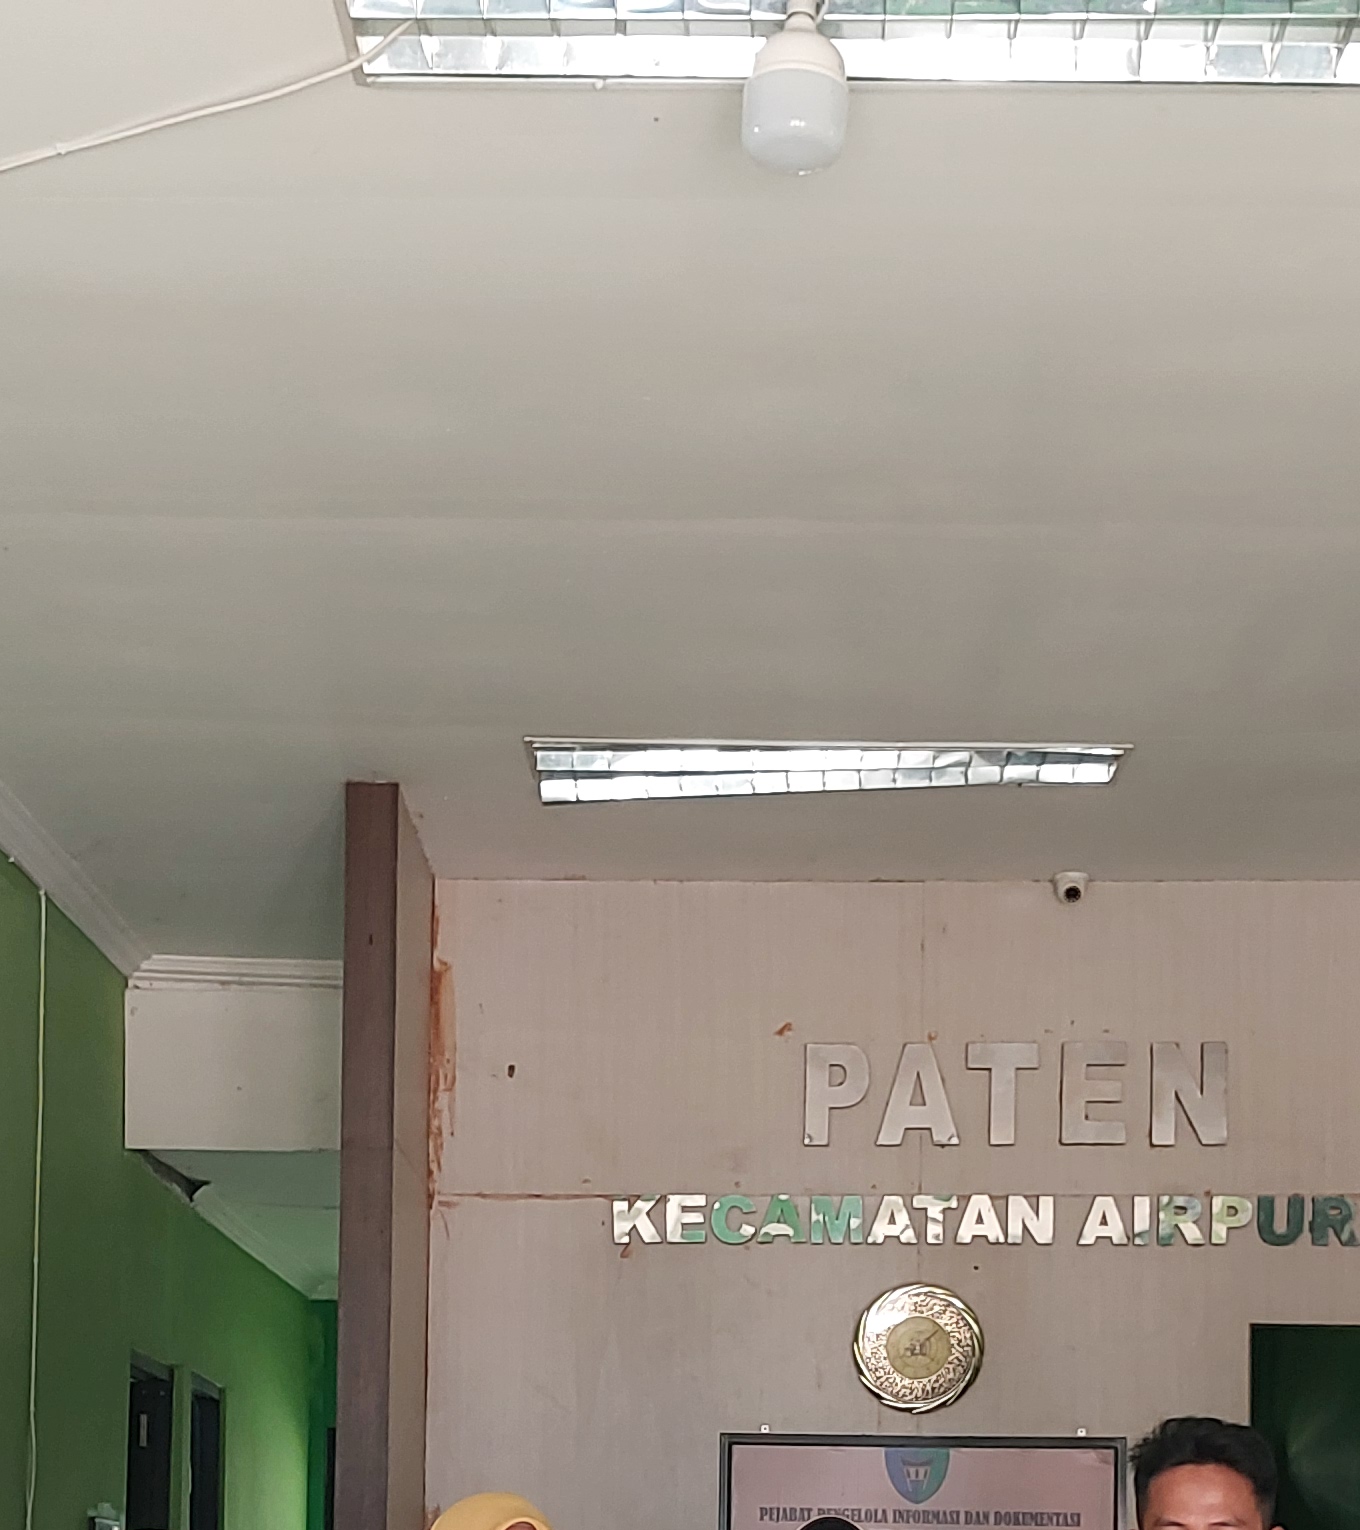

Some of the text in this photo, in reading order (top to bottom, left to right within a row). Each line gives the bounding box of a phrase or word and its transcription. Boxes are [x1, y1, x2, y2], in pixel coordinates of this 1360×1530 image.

[802, 1042, 1229, 1147] PATEN
[611, 1194, 1056, 1245] KECAMATAN
[759, 1507, 813, 1523] PEJABAT
[892, 1509, 960, 1526] INFORMASI
[964, 1510, 990, 1526] DAN
[993, 1511, 1081, 1527] DOKUMENTASI
